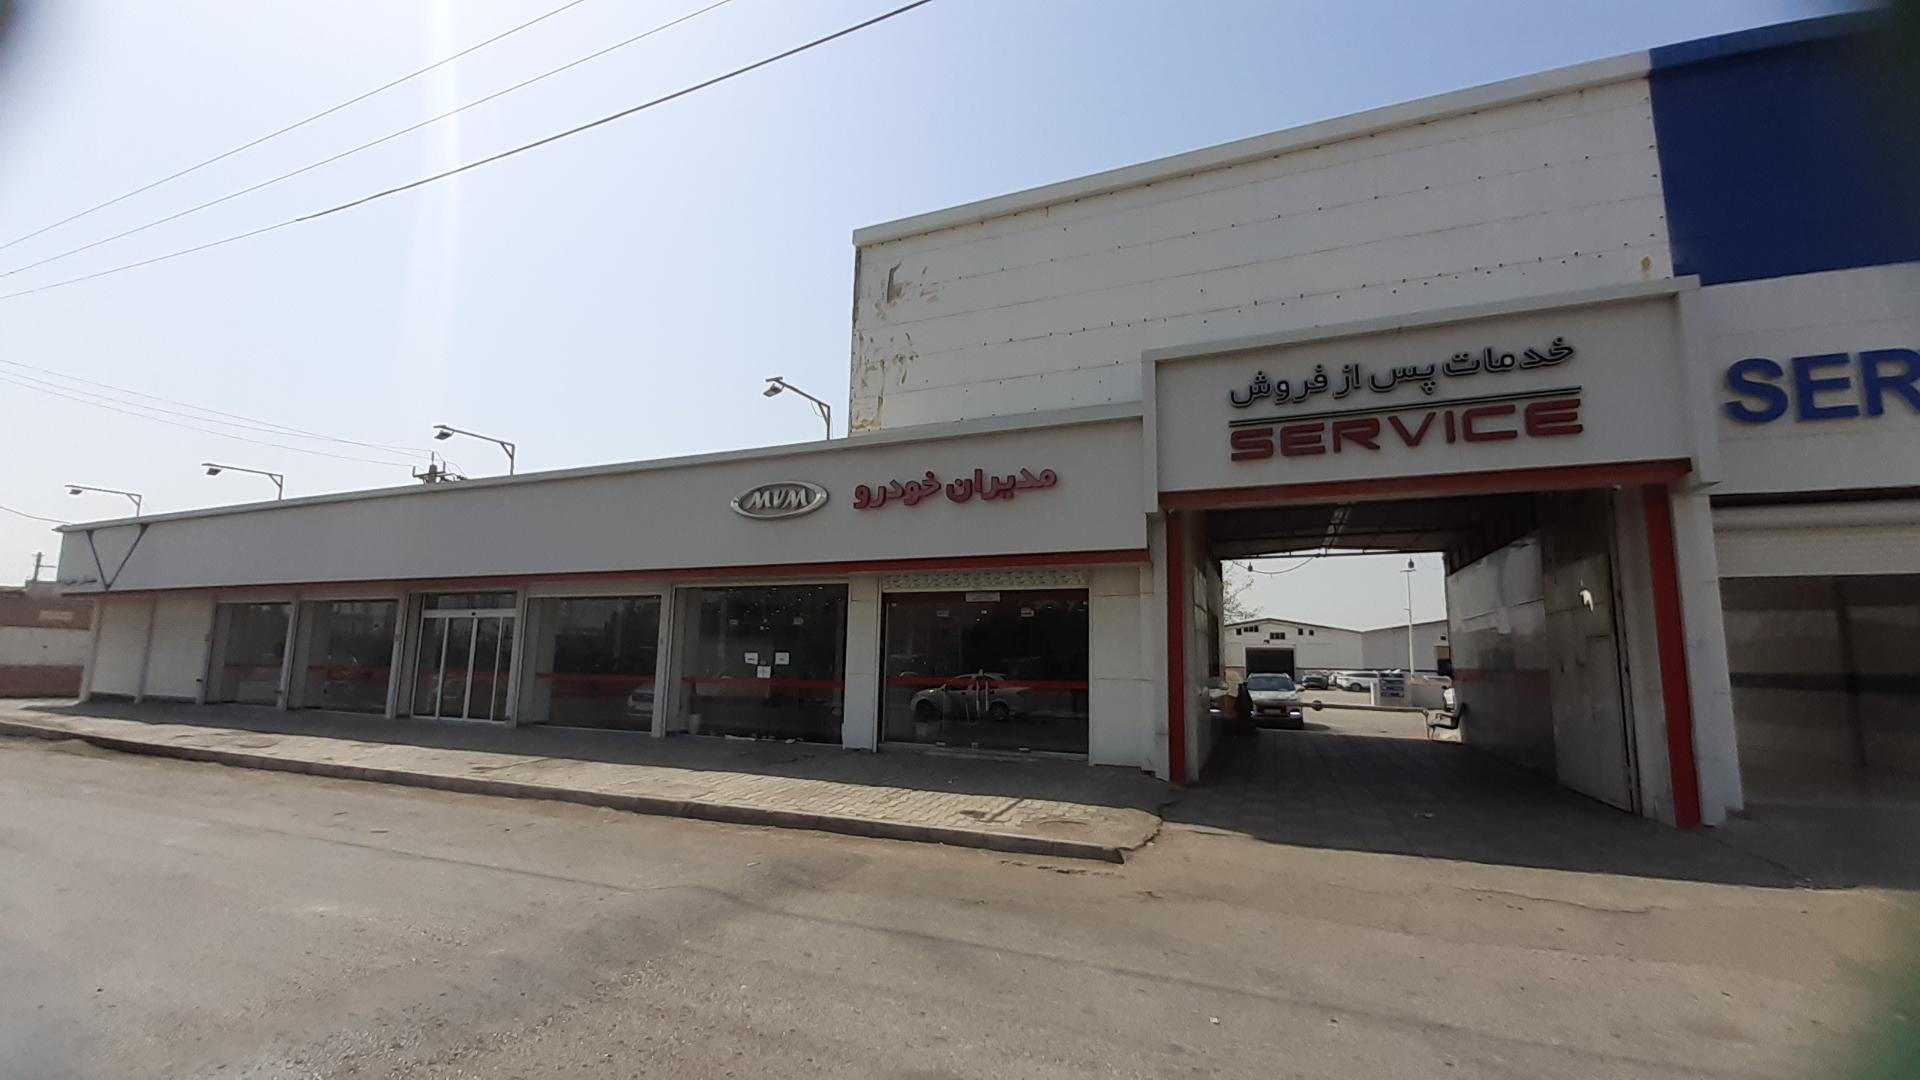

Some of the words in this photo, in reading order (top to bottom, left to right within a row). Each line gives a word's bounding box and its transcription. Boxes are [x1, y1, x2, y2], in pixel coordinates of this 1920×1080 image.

[1443, 337, 1576, 376] خدمات
[1229, 363, 1330, 408] فروش
[1333, 363, 1362, 399] از
[1369, 363, 1437, 394] پس
[1230, 398, 1584, 462] SERVICE
[744, 488, 809, 510] MVM
[853, 470, 942, 509] خودرو
[945, 468, 1058, 503] مدیران
